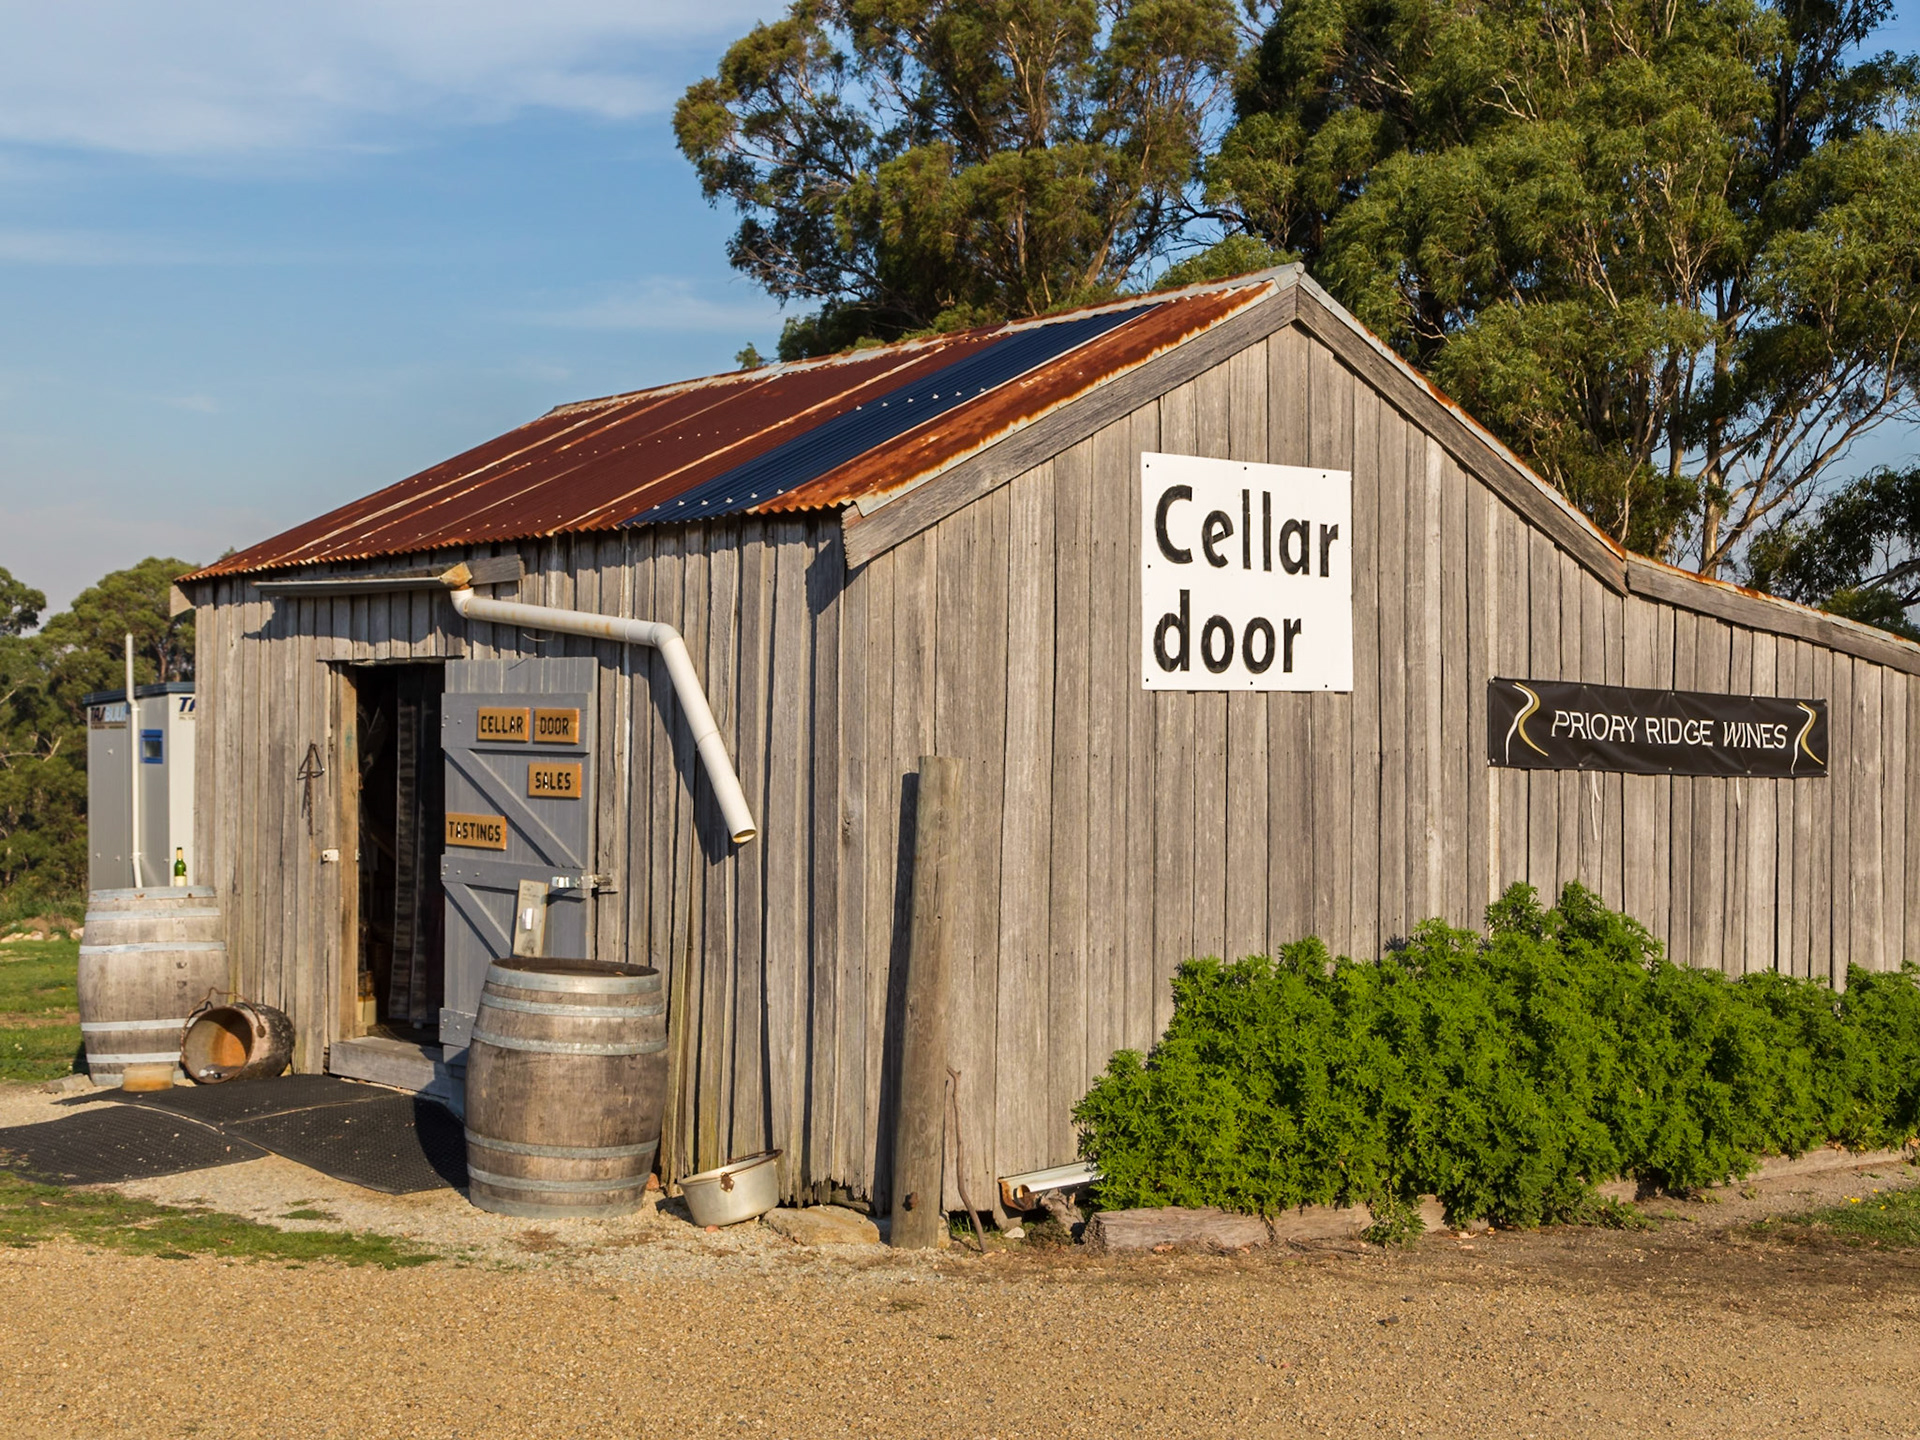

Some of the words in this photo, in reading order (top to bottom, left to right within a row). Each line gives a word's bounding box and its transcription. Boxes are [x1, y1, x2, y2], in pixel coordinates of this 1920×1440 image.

[1155, 484, 1339, 578] Cellar
[1153, 589, 1302, 674] door
[480, 715, 524, 734] CELLAR
[539, 716, 569, 736] DOOR
[1551, 710, 1638, 743] PRIORY
[1645, 718, 1715, 747] RIDGE
[1723, 722, 1789, 750] WINES
[535, 772, 571, 791] SALES
[448, 821, 501, 843] TASTINGS
